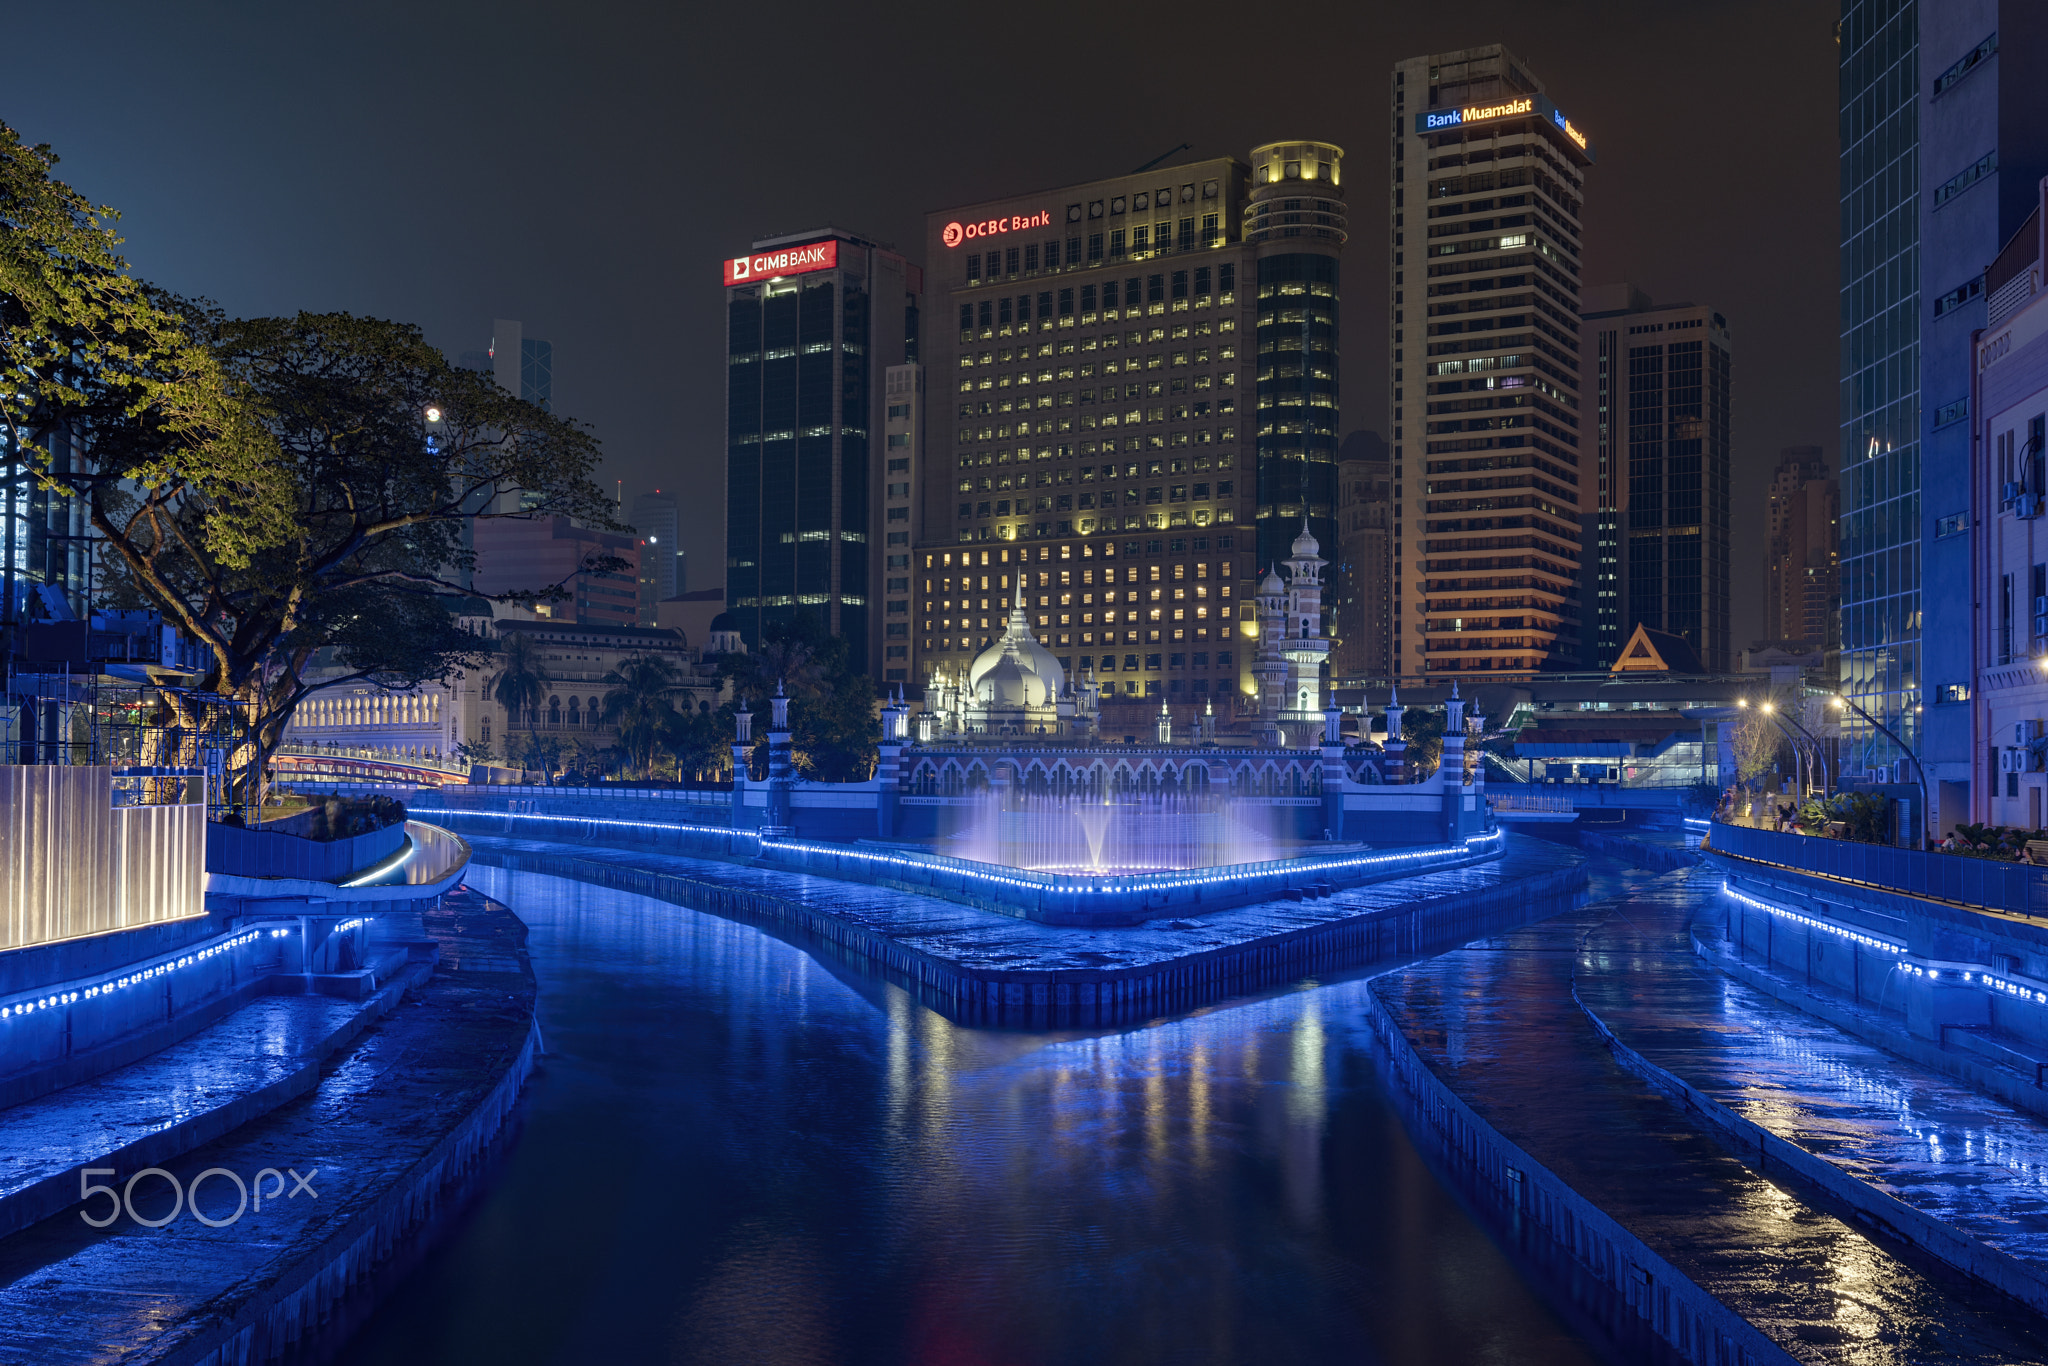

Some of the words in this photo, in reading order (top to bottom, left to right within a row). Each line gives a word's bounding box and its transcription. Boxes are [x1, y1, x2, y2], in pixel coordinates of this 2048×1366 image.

[1427, 110, 1461, 128] Bank
[1462, 98, 1532, 122] Muamalat
[1554, 109, 1566, 131] Bank
[965, 218, 1008, 239] OCBC
[1012, 210, 1050, 231] Bank
